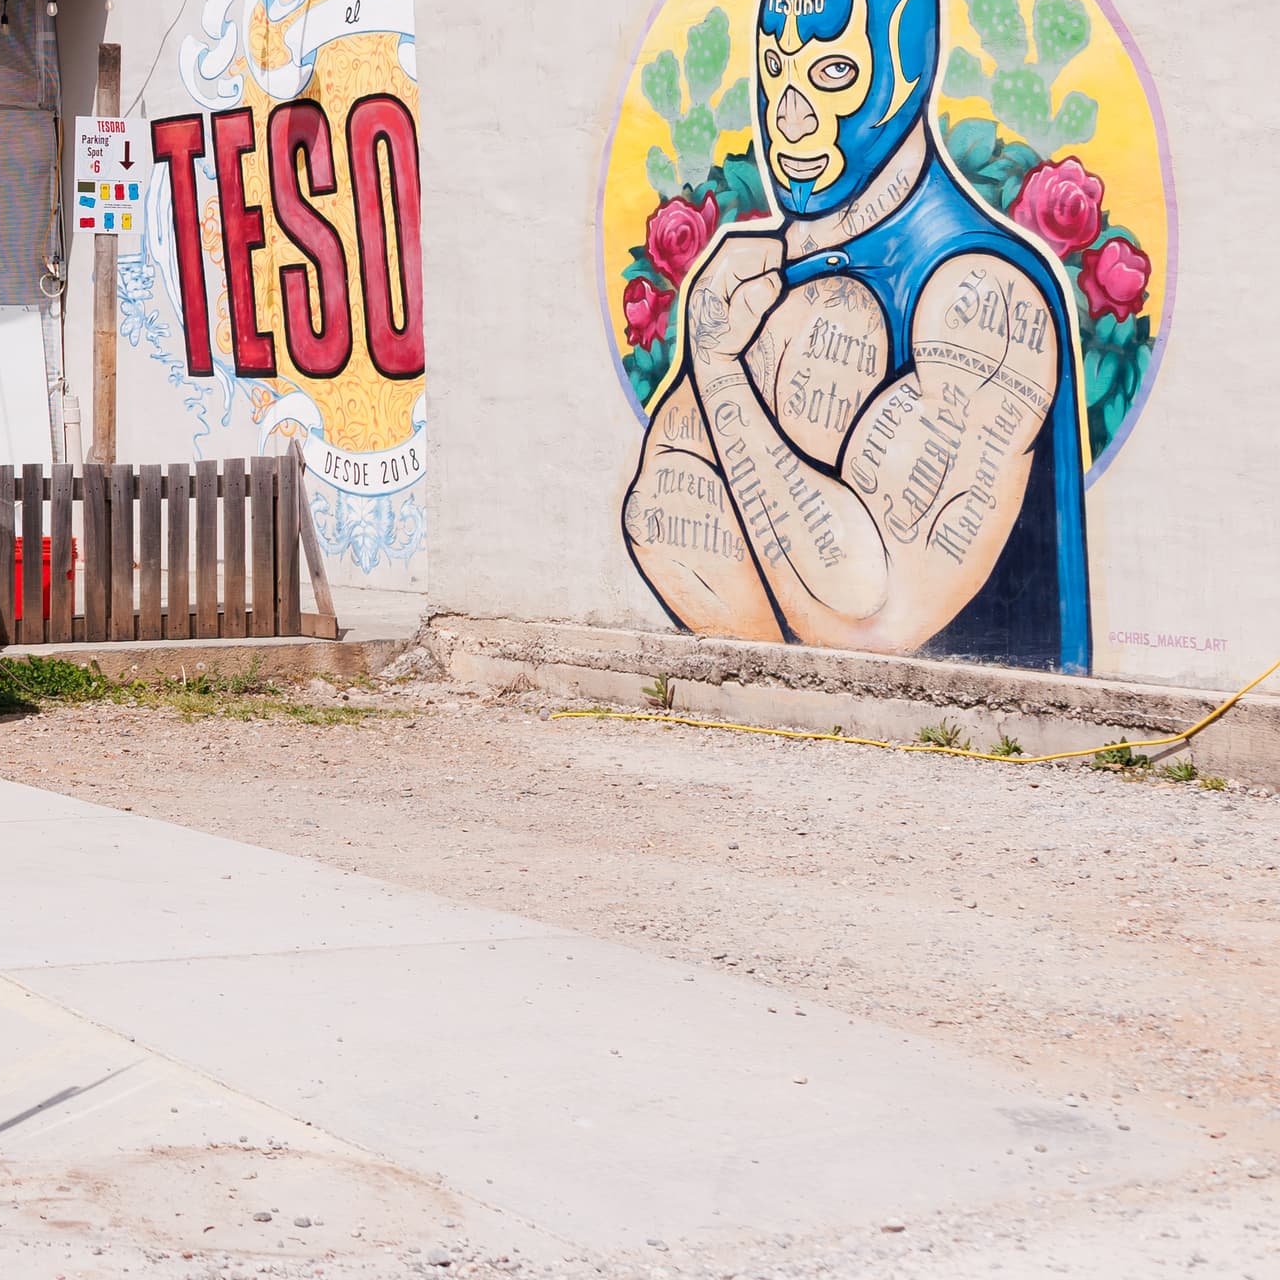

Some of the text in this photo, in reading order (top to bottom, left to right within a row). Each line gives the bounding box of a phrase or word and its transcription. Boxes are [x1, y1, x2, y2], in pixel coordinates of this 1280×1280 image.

[345, 0, 361, 24] el
[81, 134, 109, 147] Parking
[97, 120, 126, 133] TESORO
[87, 147, 103, 158] Spot
[945, 268, 1049, 354] Salsa
[802, 317, 878, 377] Birria
[324, 448, 420, 486] DESDE 2018
[715, 400, 792, 569] Tequila
[883, 381, 972, 544] Tamales
[931, 395, 1024, 565] Margaritas
[653, 468, 725, 514] Mezcal
[644, 506, 745, 562] Burritos
[1108, 631, 1228, 652] @CHRIS_MAKES_ART
